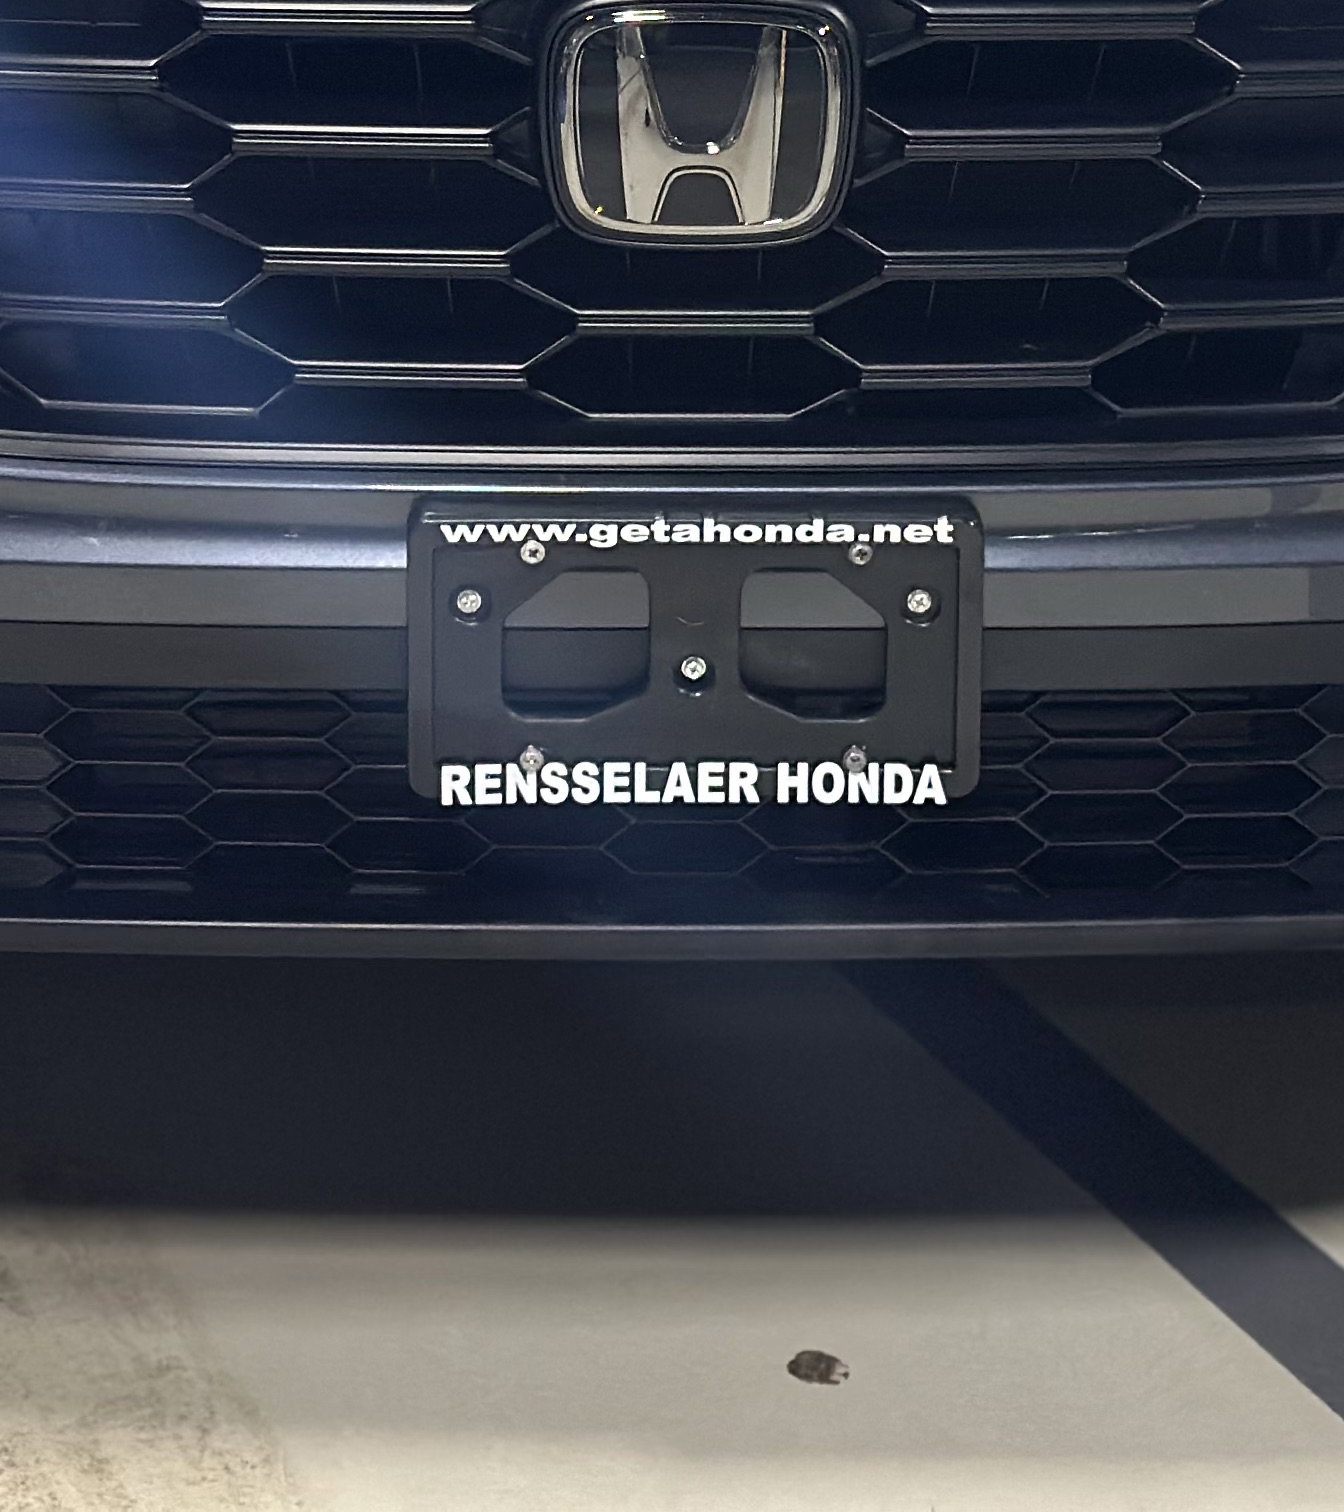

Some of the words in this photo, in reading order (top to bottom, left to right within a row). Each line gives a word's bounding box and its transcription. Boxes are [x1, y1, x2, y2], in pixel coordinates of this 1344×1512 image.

[440, 516, 954, 547] www.getahonda.net
[440, 761, 760, 806] RENSSELAER
[776, 761, 947, 806] HONDA
